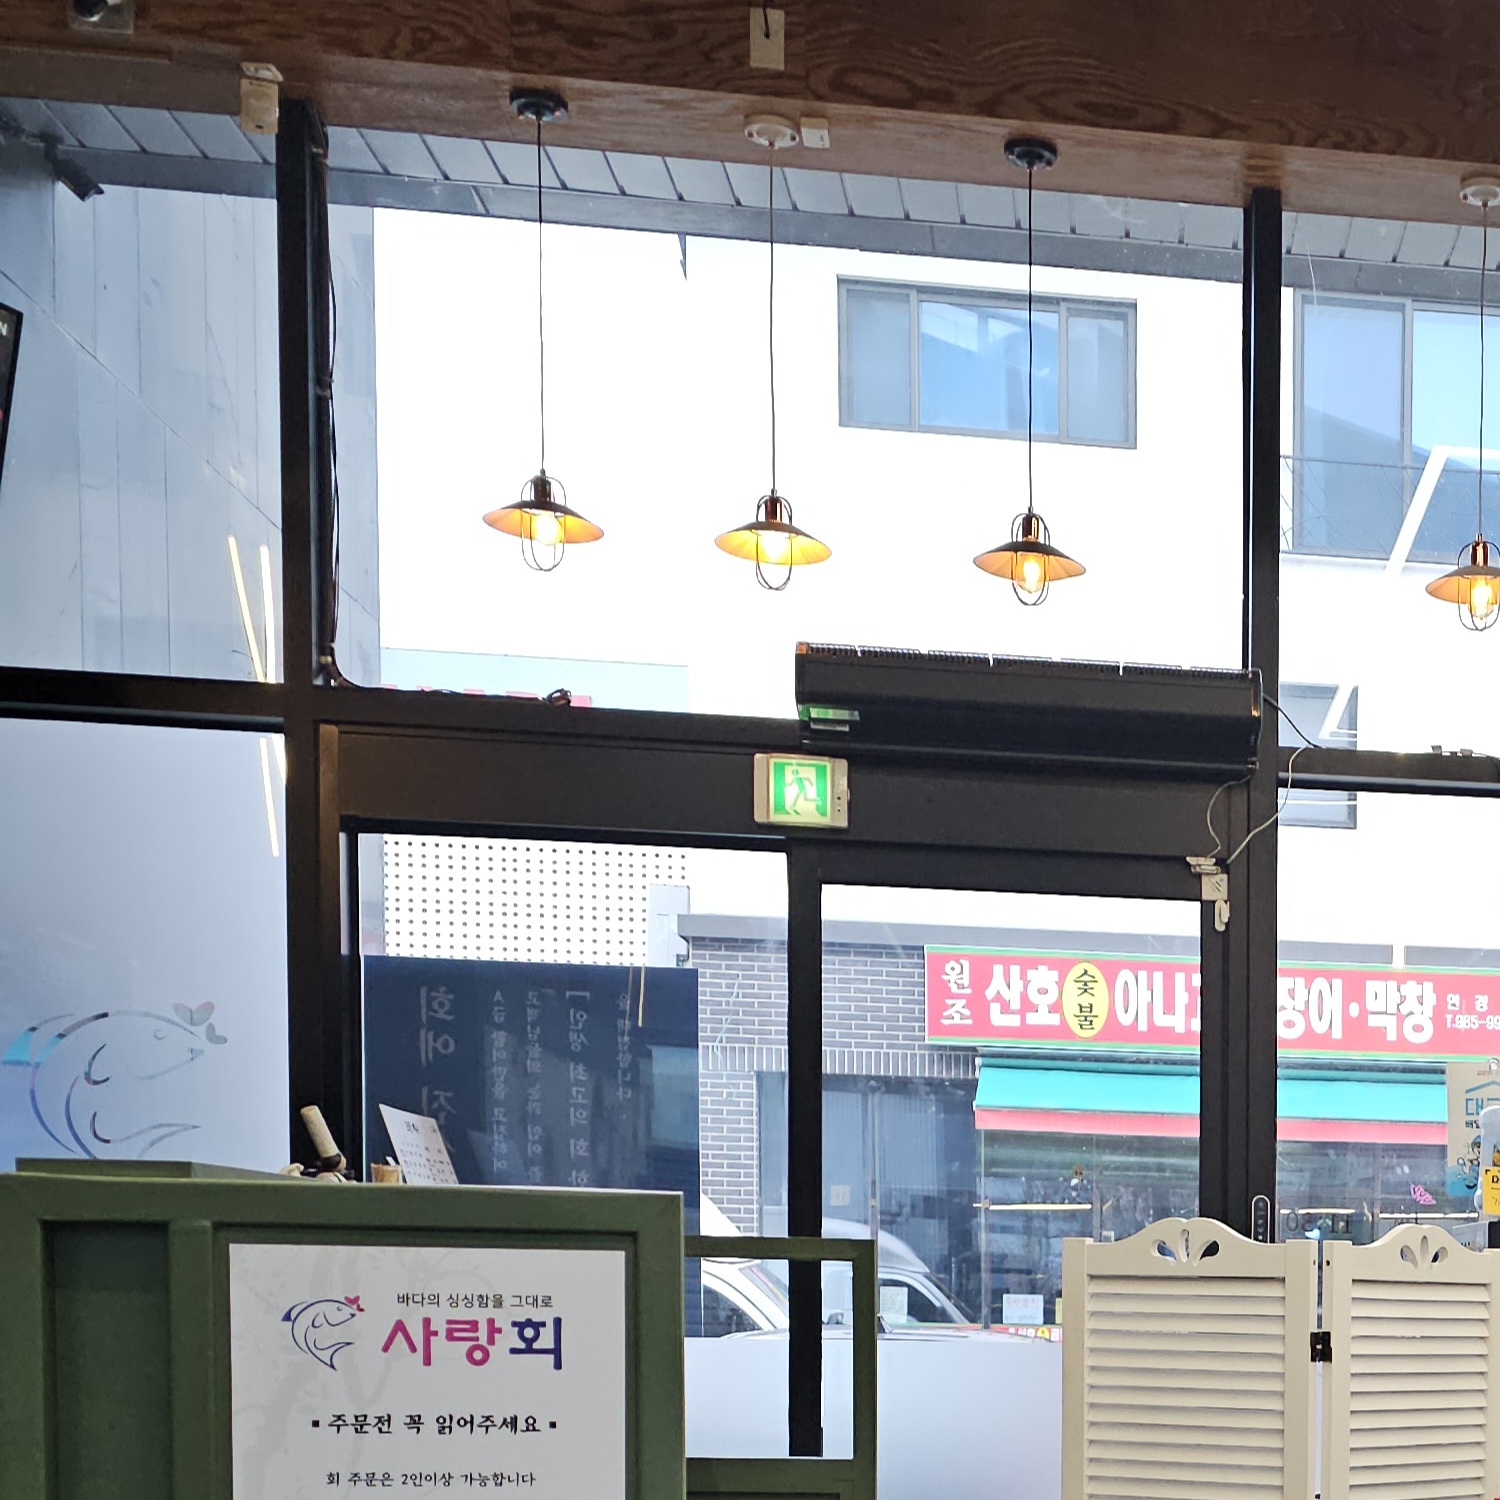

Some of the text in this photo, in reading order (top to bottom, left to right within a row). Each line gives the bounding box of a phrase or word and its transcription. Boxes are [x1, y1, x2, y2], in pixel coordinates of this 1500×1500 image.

[940, 958, 973, 1026] 원조
[984, 963, 1062, 1027] 산호
[1113, 968, 1201, 1034] 아나
[396, 1291, 441, 1309] 바다의
[509, 1293, 554, 1310] 그대로
[380, 1315, 563, 1372] 사랑회
[327, 1412, 542, 1436] 주문전 꼭 읽어주세요
[325, 1471, 537, 1488] 회 주문은 2인이상 가능합니다
